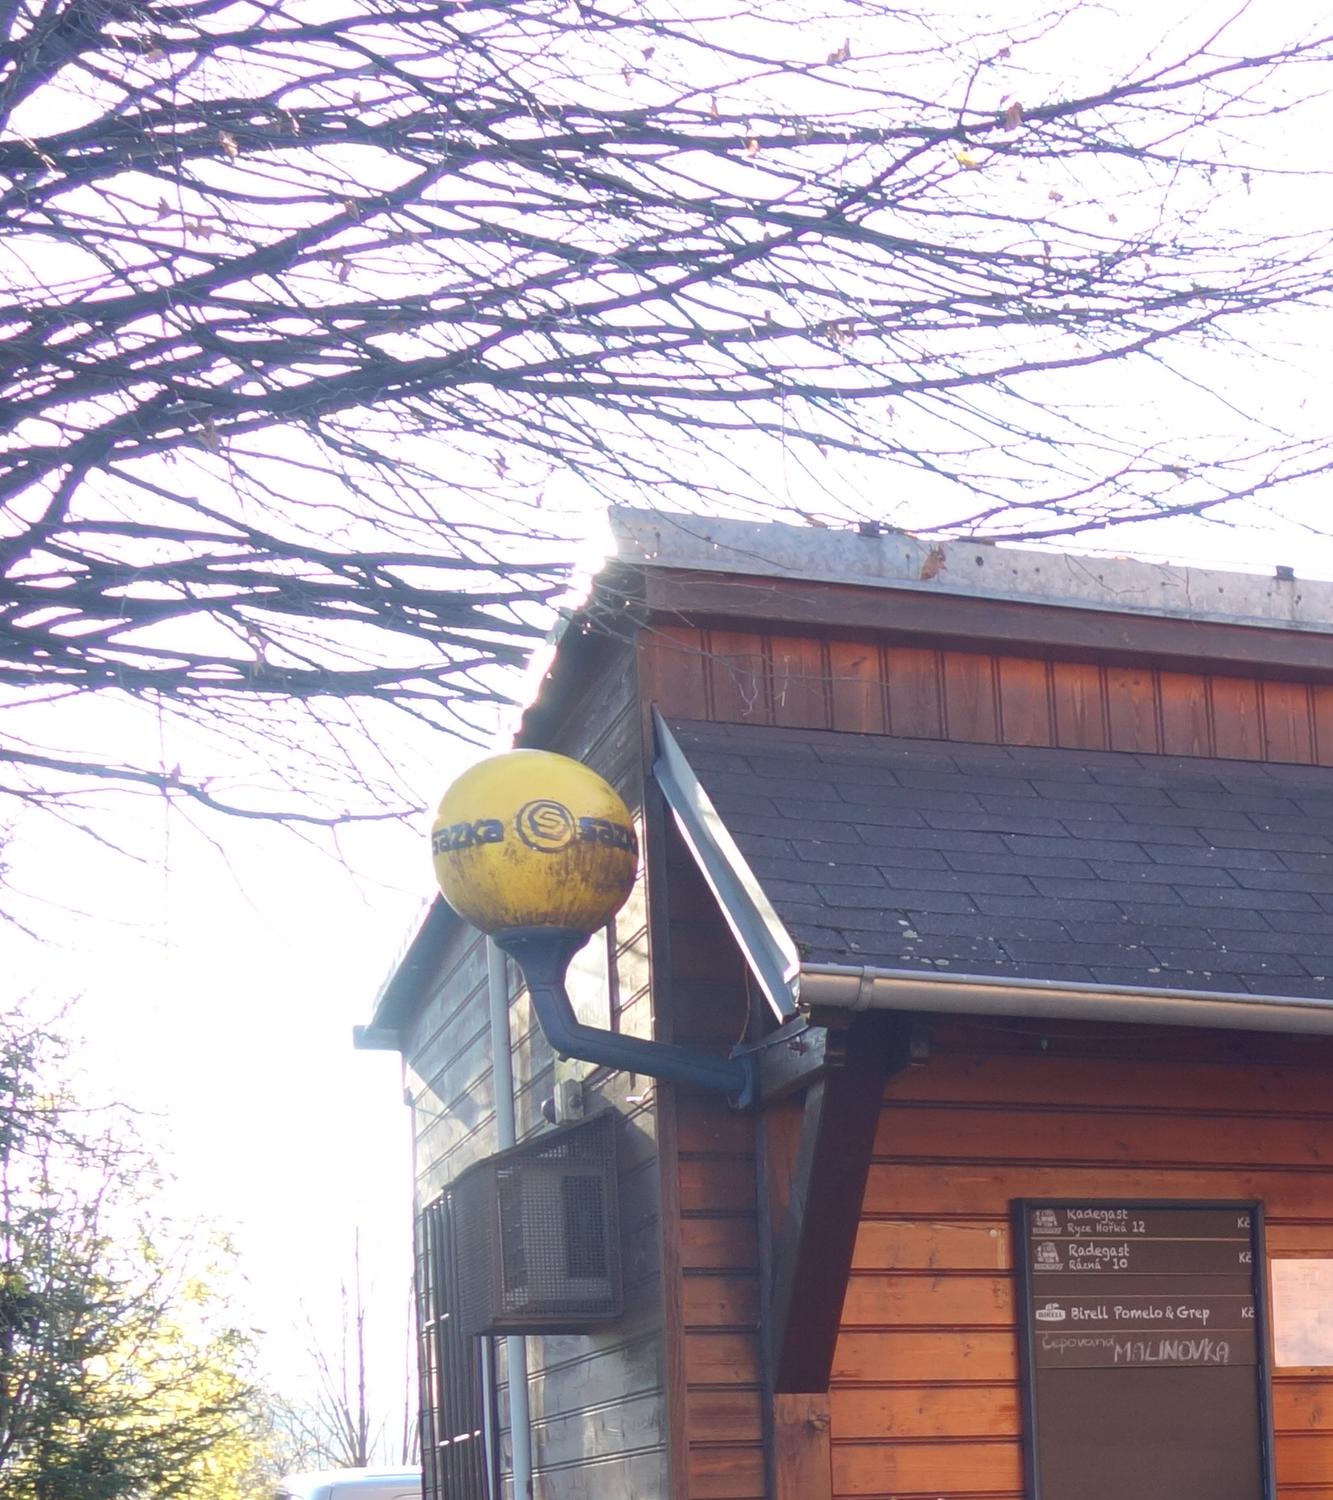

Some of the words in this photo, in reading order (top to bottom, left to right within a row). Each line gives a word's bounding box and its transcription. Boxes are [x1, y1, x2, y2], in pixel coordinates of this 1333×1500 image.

[1132, 1220, 1146, 1233] 12
[1068, 1241, 1130, 1261] Radegast
[1112, 1258, 1128, 1270] 10
[1071, 1305, 1109, 1320] Birell
[1114, 1305, 1164, 1320] Pomelo
[1165, 1307, 1175, 1319] &
[1177, 1306, 1211, 1326] Grep
[1241, 1306, 1255, 1319] Kč
[1113, 1337, 1230, 1365] MALINOVKA
